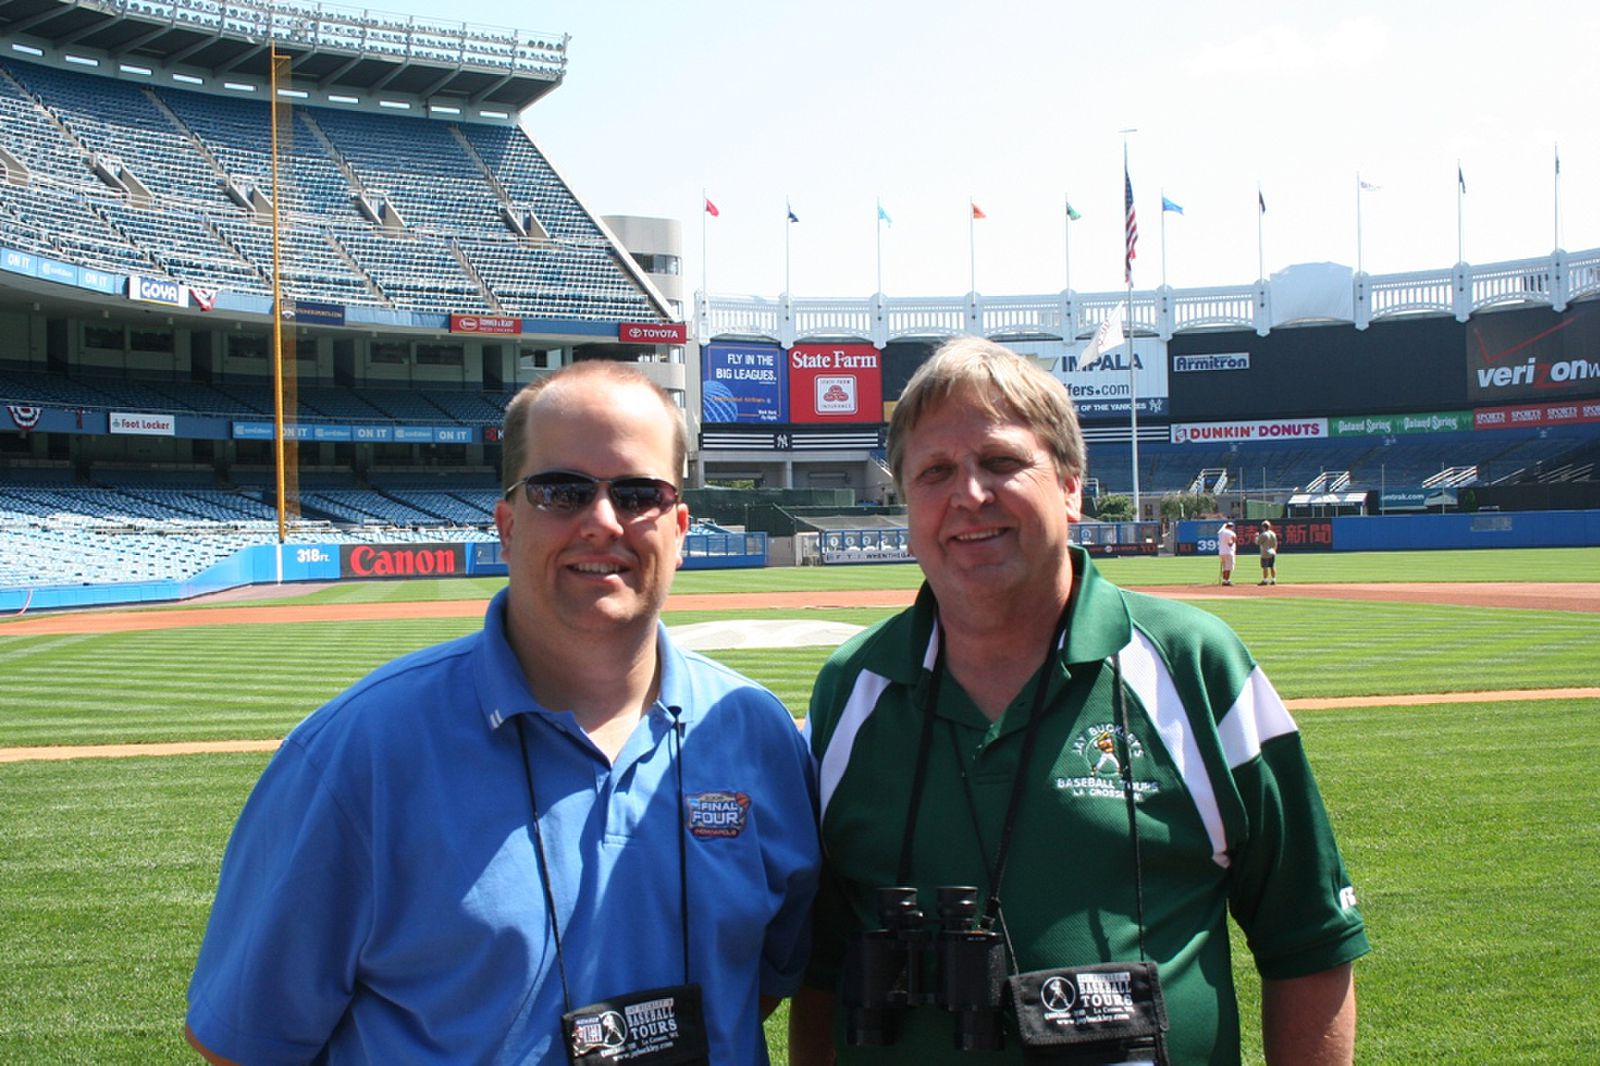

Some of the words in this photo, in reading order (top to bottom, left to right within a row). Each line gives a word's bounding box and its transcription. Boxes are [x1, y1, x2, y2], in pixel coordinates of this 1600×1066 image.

[8, 255, 20, 268] ON
[22, 257, 30, 269] IT
[85, 271, 97, 284] ON
[141, 281, 178, 300] GOYA
[642, 328, 678, 339] TOYOTA
[727, 353, 742, 365] FLY
[745, 354, 755, 365] IN
[757, 354, 774, 366] THE
[792, 350, 830, 369] State
[833, 350, 877, 368] Farm
[1176, 355, 1248, 371] Armitron
[715, 368, 732, 380] BIG
[734, 368, 777, 381] LEAGUES.
[1080, 404, 1091, 412] OF
[1093, 403, 1109, 411] THE
[121, 418, 140, 428] Foot
[142, 419, 170, 430] Locker
[357, 429, 374, 438] ON
[376, 429, 387, 438] IT
[438, 431, 455, 440] ON
[456, 431, 467, 440] IT
[1190, 425, 1255, 440] DUNKIN'
[1258, 423, 1320, 438] DONUTS
[1197, 539, 1219, 551] 39
[350, 545, 455, 576] Canon
[1057, 777, 1116, 789] BASEBALL
[701, 802, 738, 811] FINAL
[691, 811, 739, 825] FOUR
[1079, 981, 1132, 994] BASEBALL
[1080, 994, 1134, 1008] TOURS
[627, 1006, 675, 1027] BASEBALL
[630, 1019, 678, 1040] TOURS
